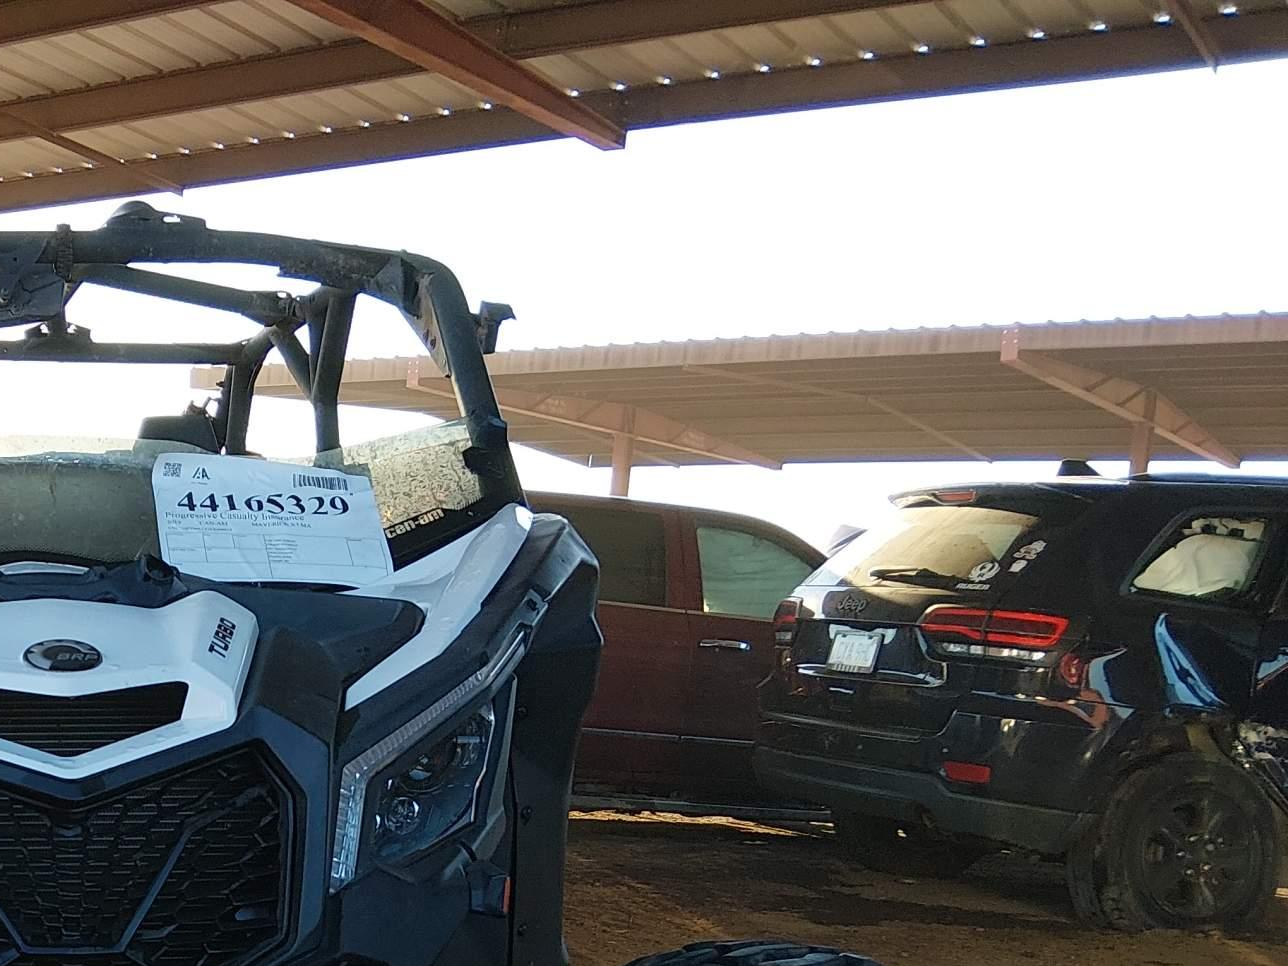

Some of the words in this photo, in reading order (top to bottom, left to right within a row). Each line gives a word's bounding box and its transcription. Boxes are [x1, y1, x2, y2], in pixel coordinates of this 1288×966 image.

[177, 491, 350, 515] 44165329
[165, 511, 218, 521] Progressive
[219, 511, 259, 522] Casualty
[384, 508, 445, 539] can-am
[838, 594, 867, 612] Jeep
[207, 616, 237, 659] TURBO
[56, 652, 99, 661] BRP
